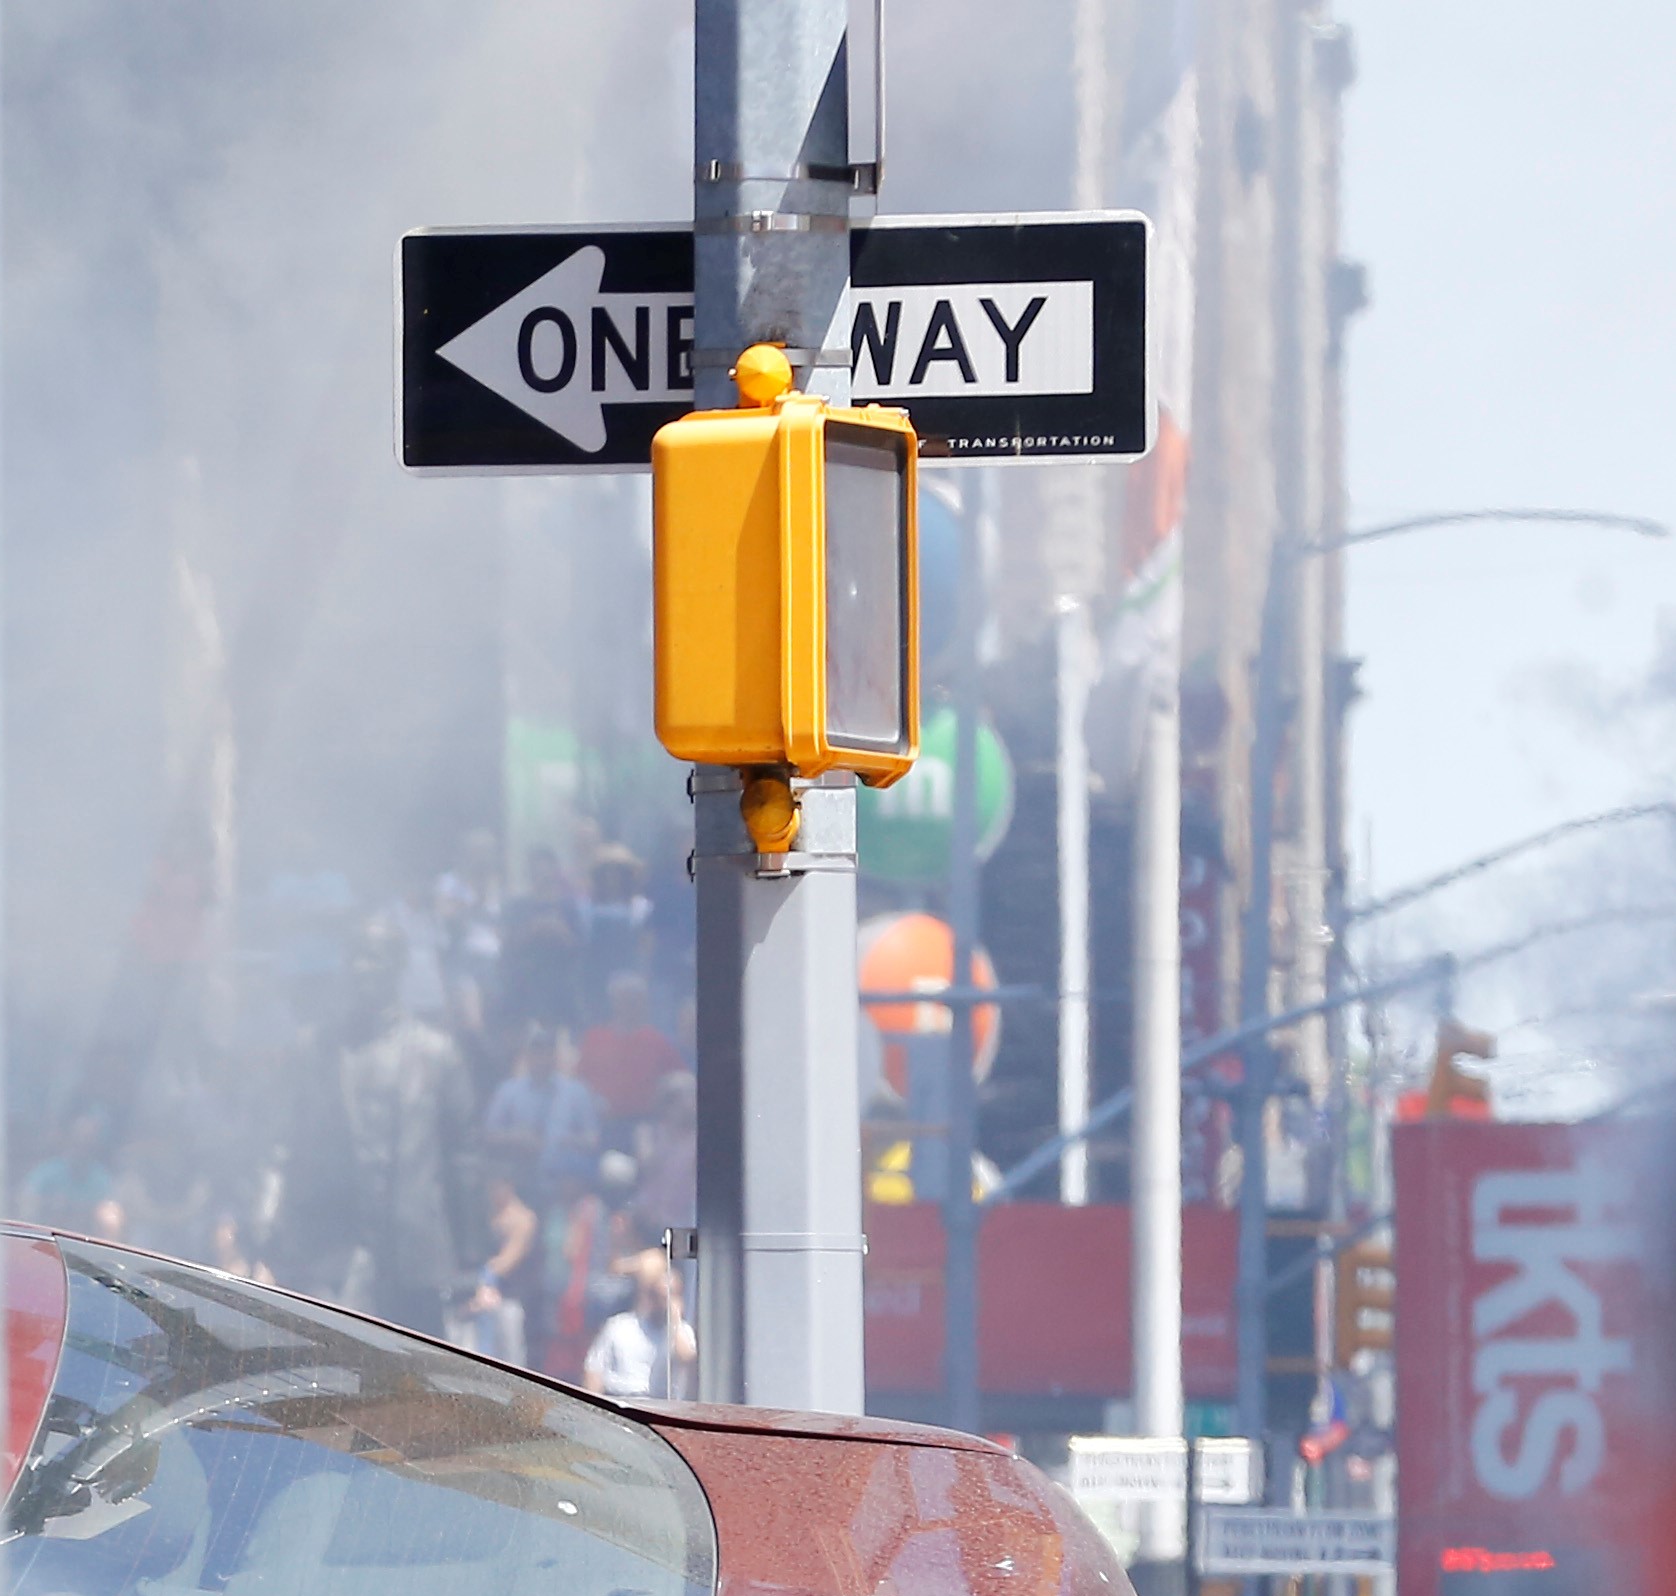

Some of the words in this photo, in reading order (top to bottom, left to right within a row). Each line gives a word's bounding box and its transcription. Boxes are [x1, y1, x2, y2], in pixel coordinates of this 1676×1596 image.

[516, 304, 695, 396] ONE
[851, 294, 1047, 387] WAY
[947, 435, 1115, 449] TRANSPORTATION
[1471, 1155, 1641, 1501] tkts
